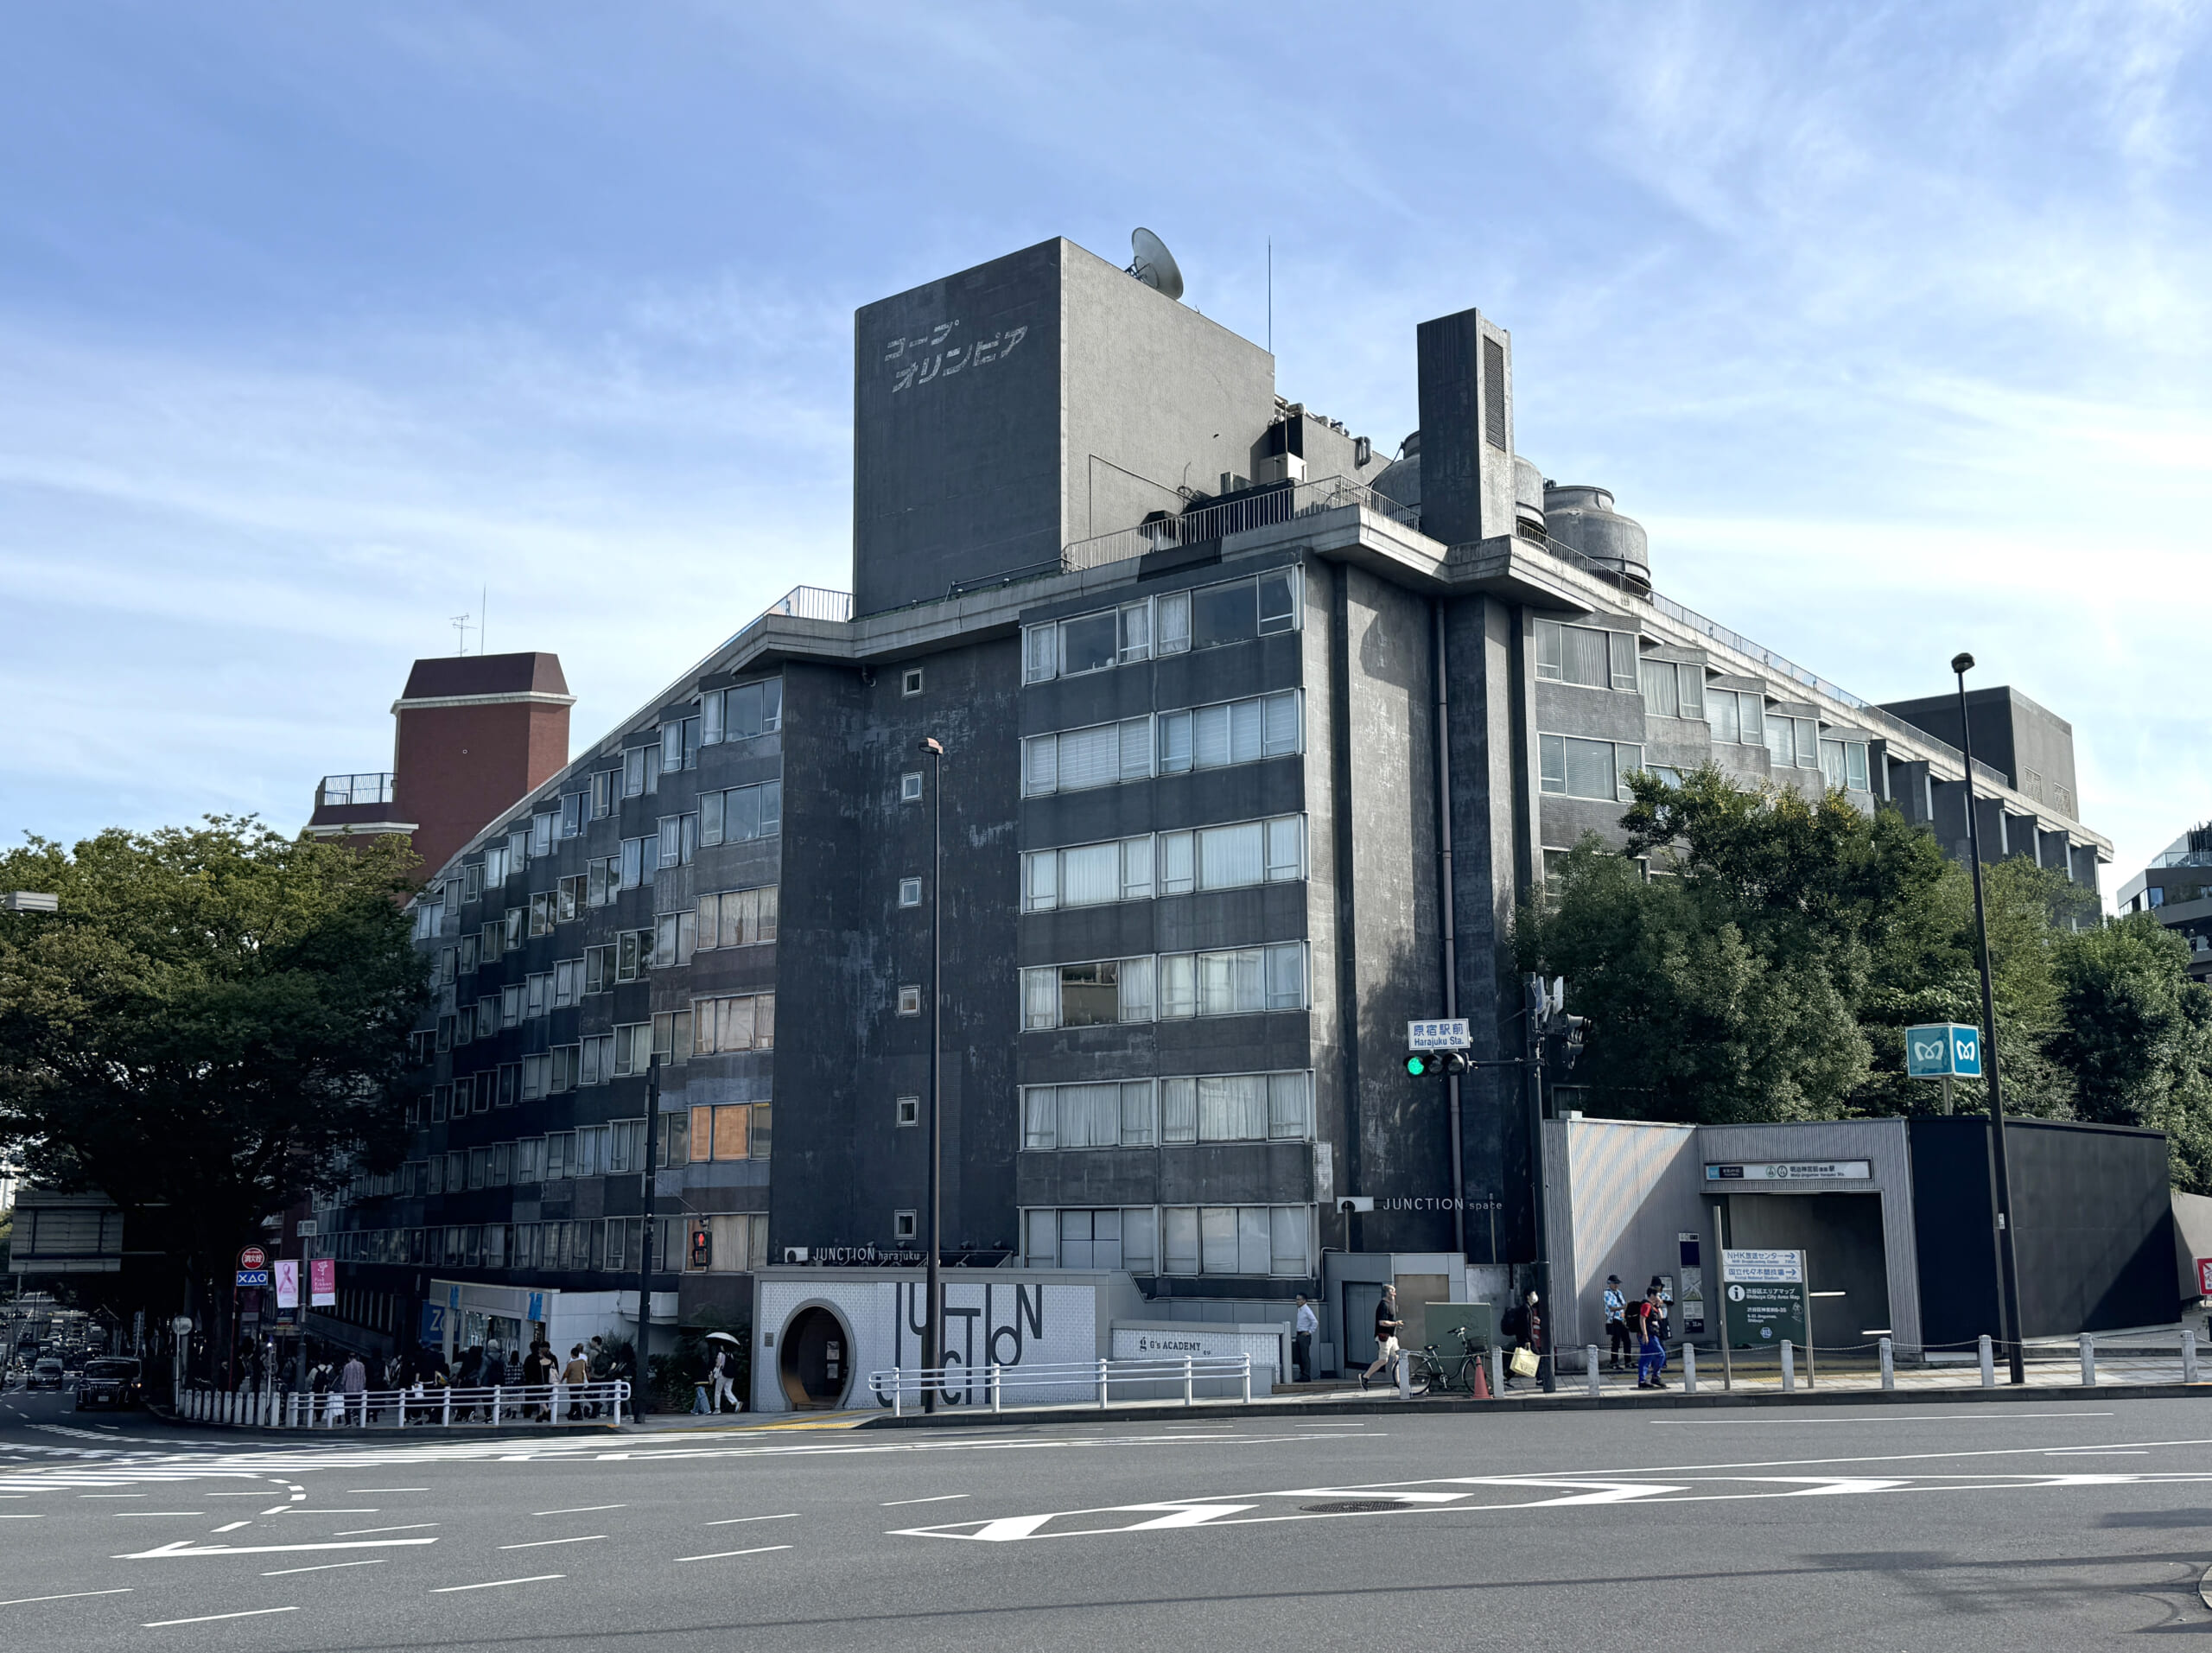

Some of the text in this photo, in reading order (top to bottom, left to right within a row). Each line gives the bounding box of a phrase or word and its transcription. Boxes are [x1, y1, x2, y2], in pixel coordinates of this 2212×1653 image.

[885, 319, 960, 361] コープ
[892, 326, 1028, 393] オリンピア
[1414, 1023, 1464, 1037] 原宿駅前
[1414, 1036, 1464, 1047] Harajuku Sta.
[1382, 1198, 1503, 1211] JUNCTION space
[813, 1247, 920, 1262] JUNCTION harajuku
[1150, 1340, 1161, 1349] G's
[1162, 1341, 1201, 1351] ACADEMY
